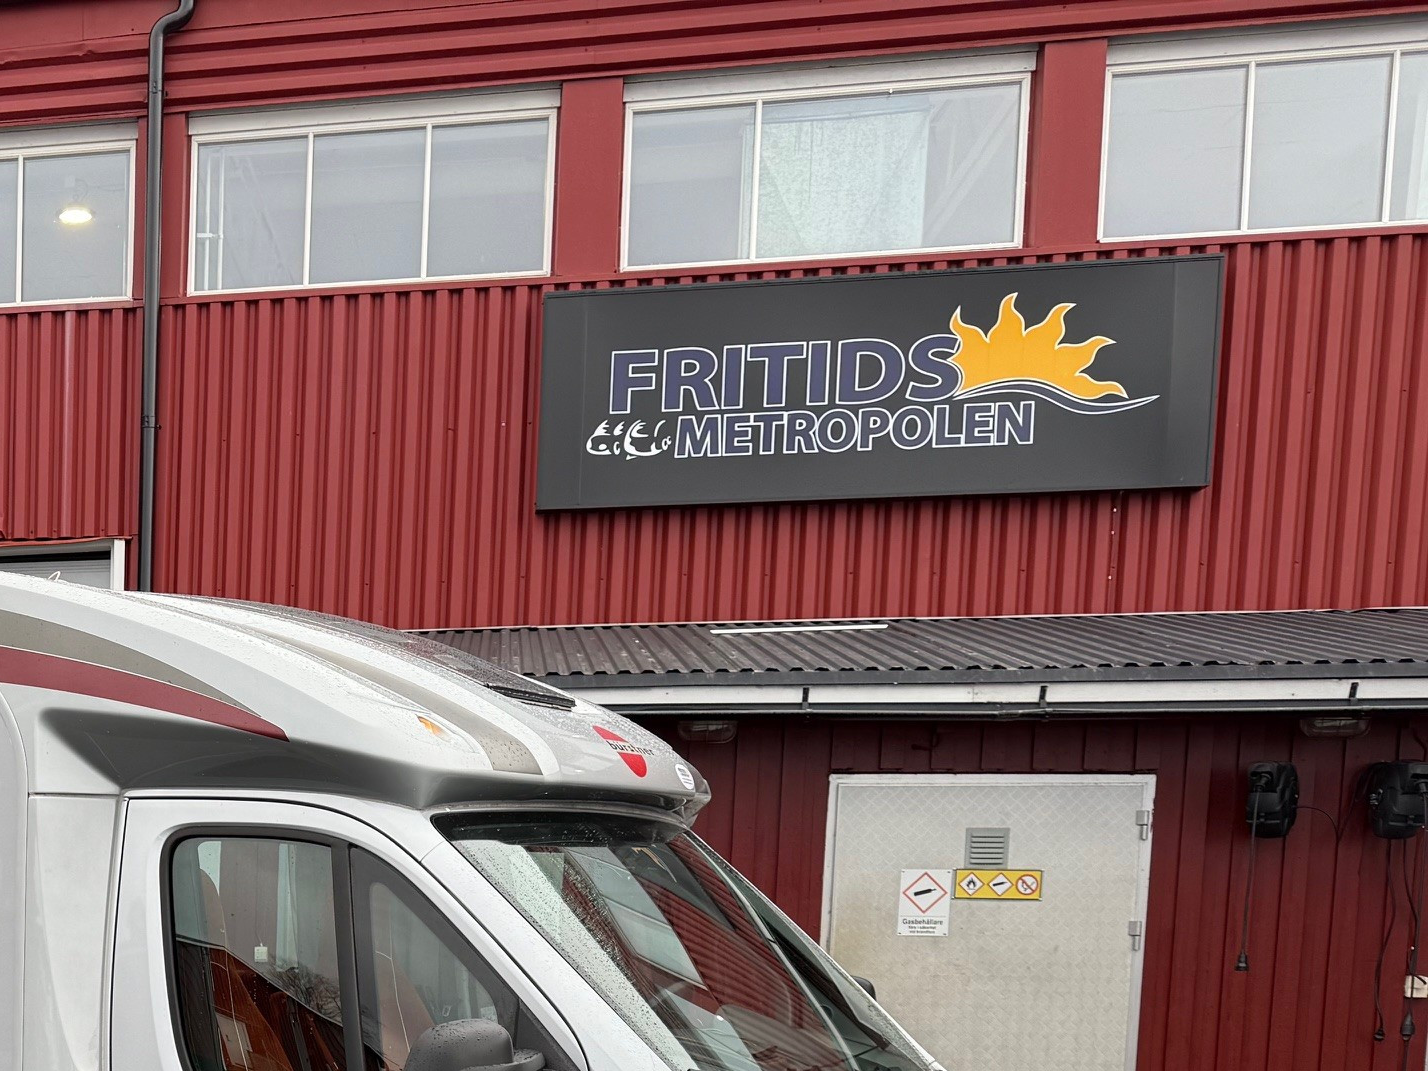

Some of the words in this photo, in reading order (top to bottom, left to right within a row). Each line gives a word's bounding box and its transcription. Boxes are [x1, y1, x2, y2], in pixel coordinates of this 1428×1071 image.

[609, 334, 963, 414] FRITIDS
[673, 401, 1036, 459] METROPOLEN
[605, 740, 655, 756] bürstner
